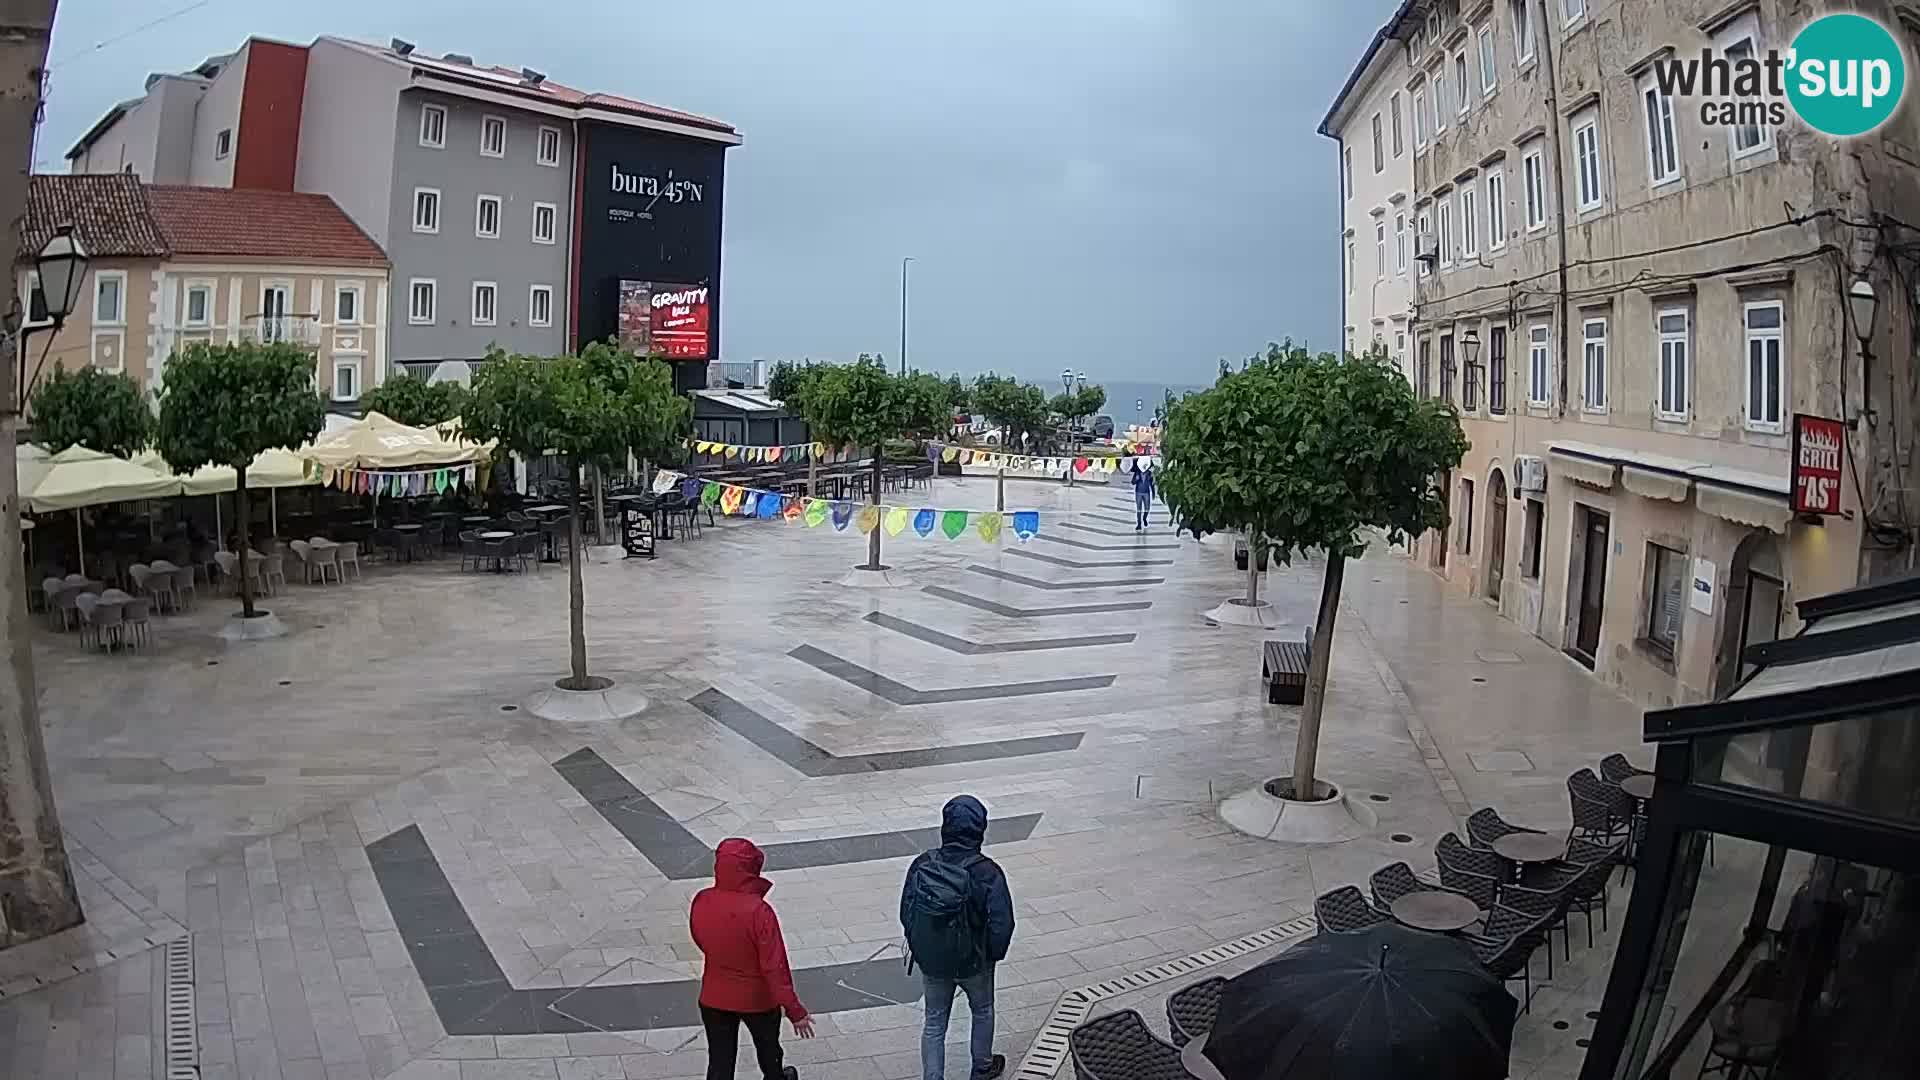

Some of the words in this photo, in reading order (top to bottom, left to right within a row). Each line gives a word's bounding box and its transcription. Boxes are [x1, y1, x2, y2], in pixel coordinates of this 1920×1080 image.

[611, 165, 658, 196] bura
[651, 287, 708, 309] GRAVITY
[1799, 447, 1839, 472] GRILL
